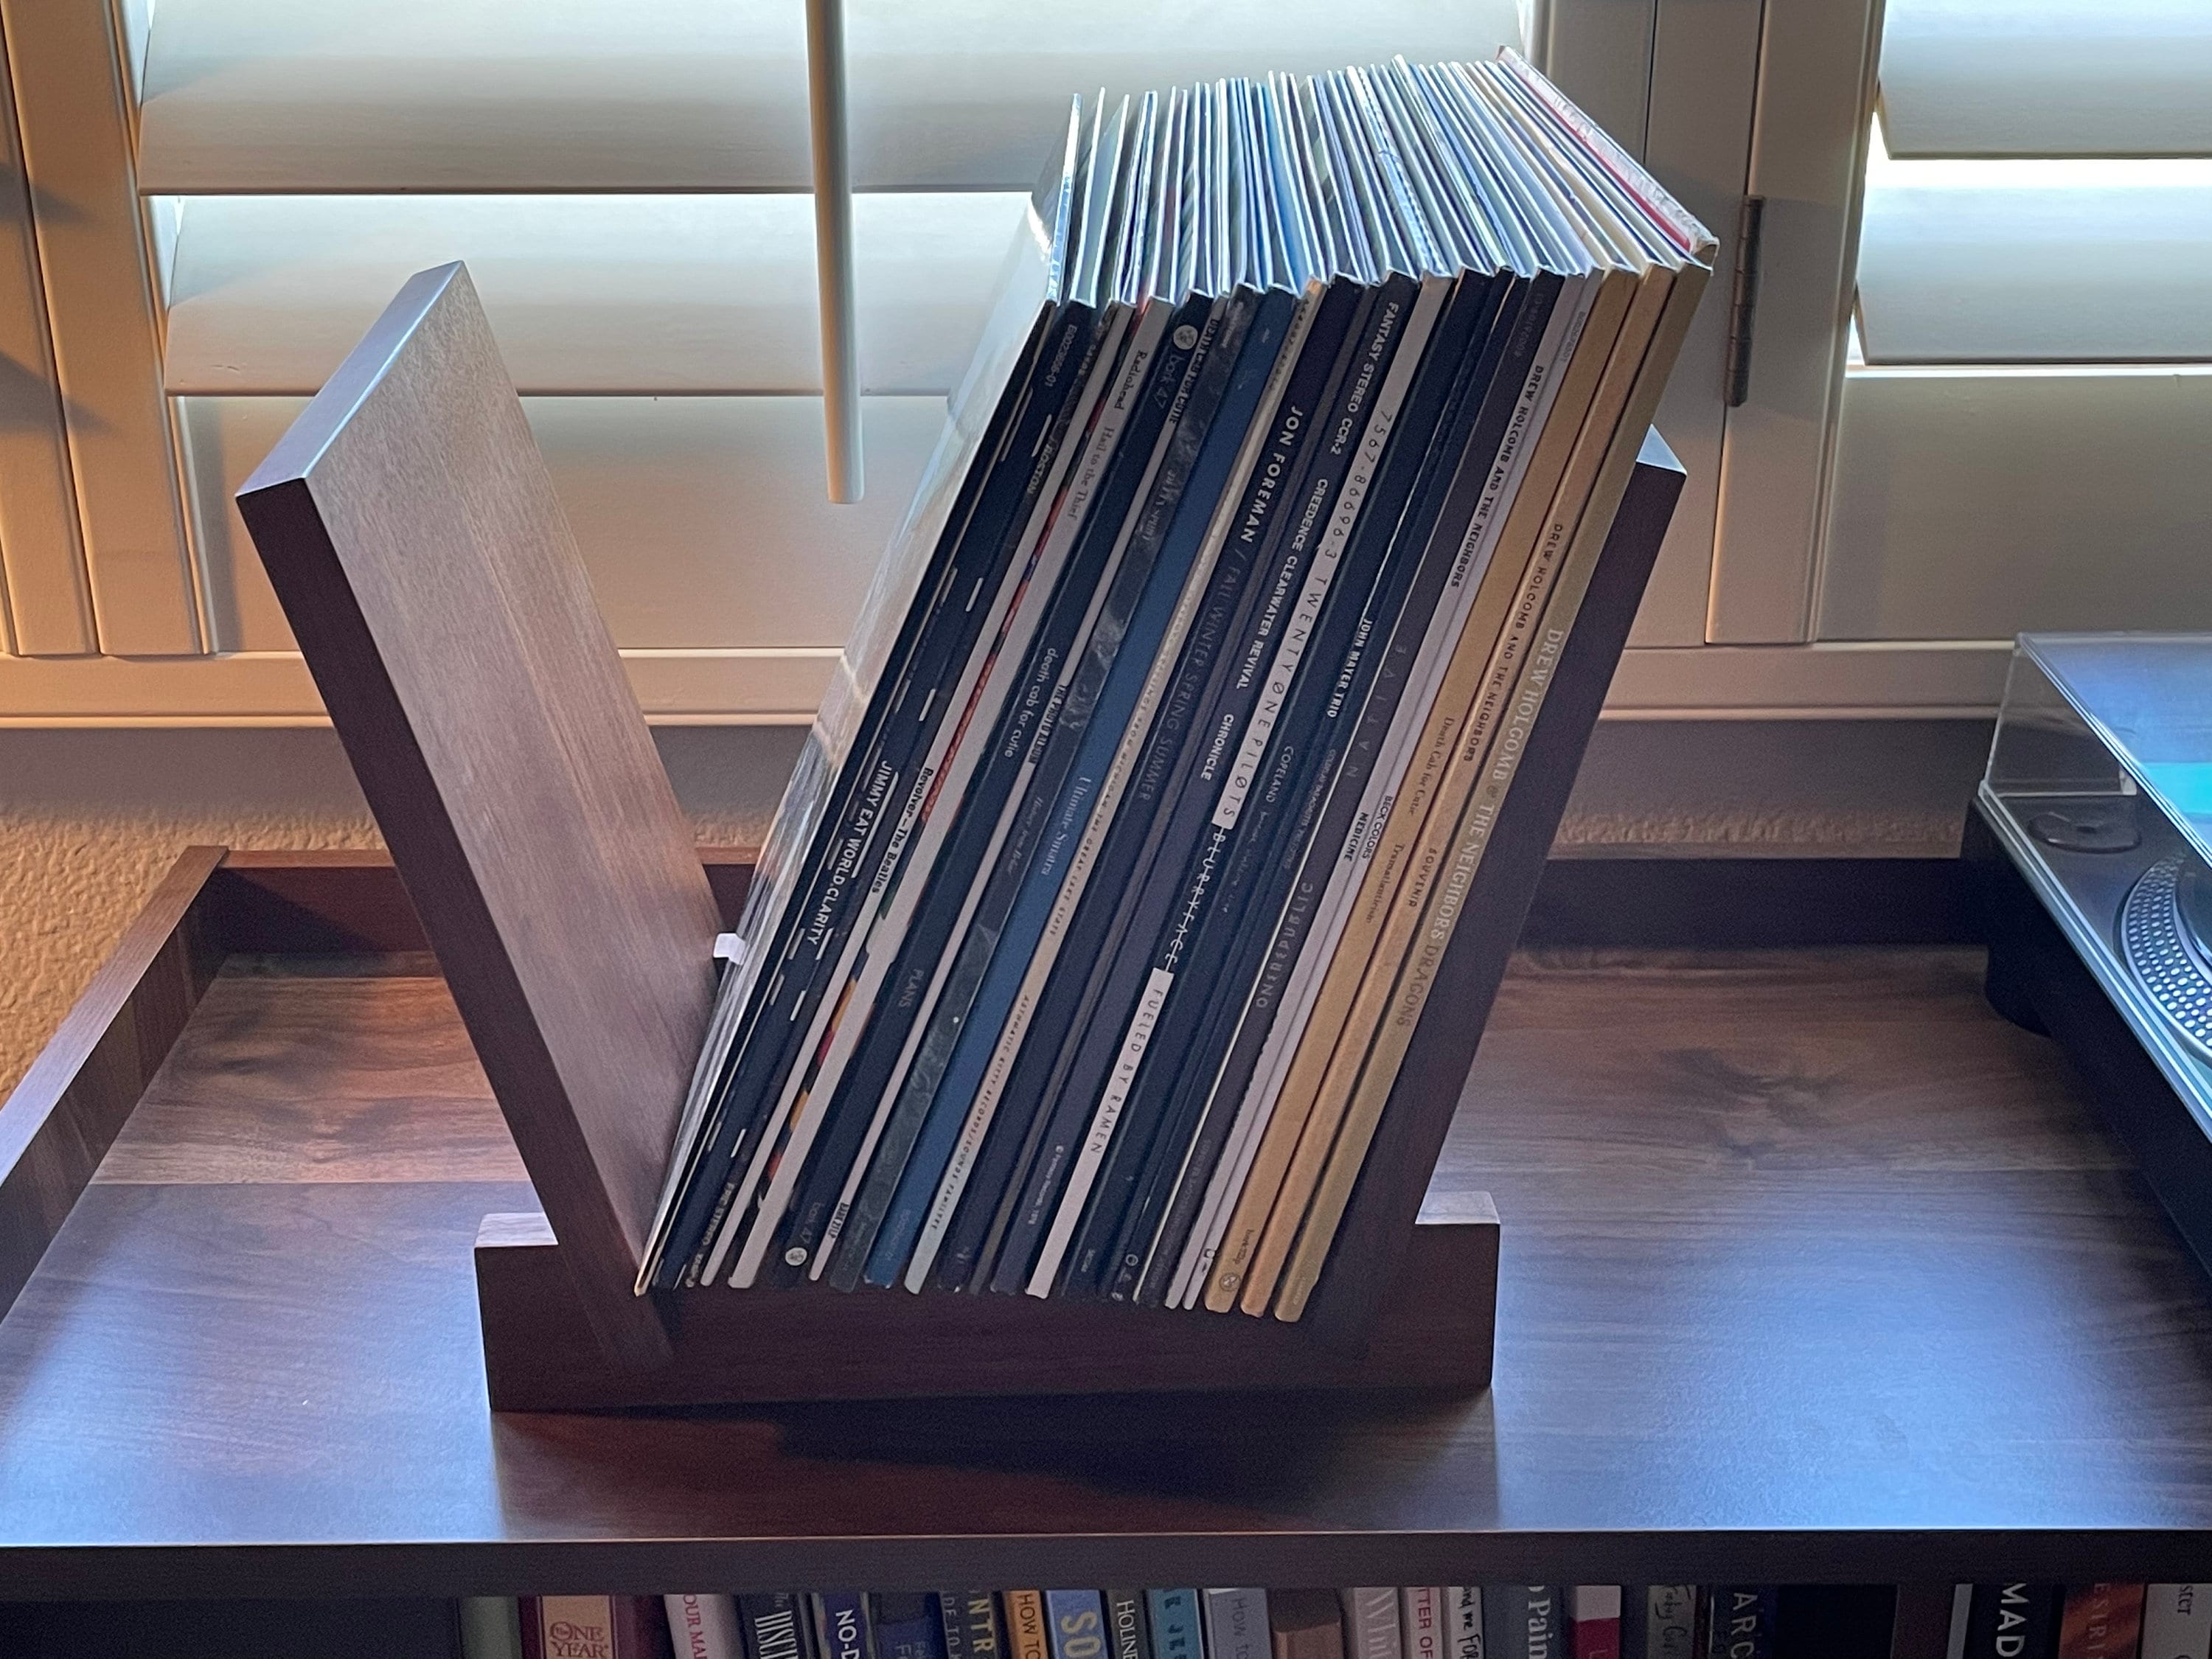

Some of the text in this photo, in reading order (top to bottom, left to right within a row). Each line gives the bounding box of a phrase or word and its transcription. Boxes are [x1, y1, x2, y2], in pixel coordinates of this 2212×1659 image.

[1113, 350, 1148, 409] Radiohead
[1150, 355, 1183, 407] bark 47
[1168, 319, 1219, 423] DEATH CAB FOR CUTIE
[1328, 302, 1400, 454] FANTASY STEREO CCR-2
[1523, 366, 1545, 401] DREW
[1276, 406, 1306, 445] JON
[1498, 407, 1528, 462] HOLCOMB
[1024, 443, 1054, 496] BOSTON
[1065, 428, 1115, 521] Hail to the Thief
[1238, 453, 1287, 543] FOREMAN
[1487, 466, 1505, 490] AND
[1477, 497, 1493, 518] THE
[1217, 566, 1242, 597] FALL
[1234, 479, 1329, 689] CREEDENCE CLEARWATER REVIVAL
[1448, 523, 1483, 588] NEIGHBORS
[1189, 605, 1226, 664] WINTER
[1276, 577, 1327, 671] TWENTY
[1461, 524, 1564, 762] DREW HOLCOMB AND THE NEIGHBORS
[1324, 619, 1374, 717] JOHN MAYER TRIO
[1528, 629, 1564, 686] DREW
[1003, 648, 1060, 757] death cab for cutie
[1026, 685, 1067, 763] THE PHOTO ALBUM
[1164, 673, 1199, 728] SPRING
[1198, 714, 1235, 781] CHRONICLE
[1491, 690, 1540, 779] HOLCOMB
[863, 760, 894, 806] JIMMY
[903, 768, 933, 818] Revolver
[1136, 736, 1174, 800] SUMMER
[1264, 745, 1295, 802] COPELAND
[1407, 717, 1455, 815] Death Cab for Cutie
[852, 808, 874, 835] EAT
[891, 828, 908, 848] The
[1040, 777, 1091, 875] Ultimate Sinatra
[1341, 812, 1370, 862] MEDICINE
[1360, 795, 1394, 859] BECK COLORS
[1470, 804, 1495, 835] THE
[871, 852, 897, 894] Beatles
[1161, 832, 1228, 964] BLURRYFACE
[1363, 843, 1405, 924] Transatlanticism
[1405, 848, 1438, 908] SOUVENIR
[1427, 842, 1480, 939] NEIGHBORS
[1251, 882, 1315, 1009] ONEREPUBLIC
[897, 968, 925, 1008] PLANS
[1394, 945, 1441, 1026] DRAGONS
[1089, 989, 1164, 1154] FUELED BY RAMEN
[550, 1621, 605, 1642] ONE
[1018, 1594, 1038, 1635] HOW
[551, 1641, 606, 1658] YEAR
